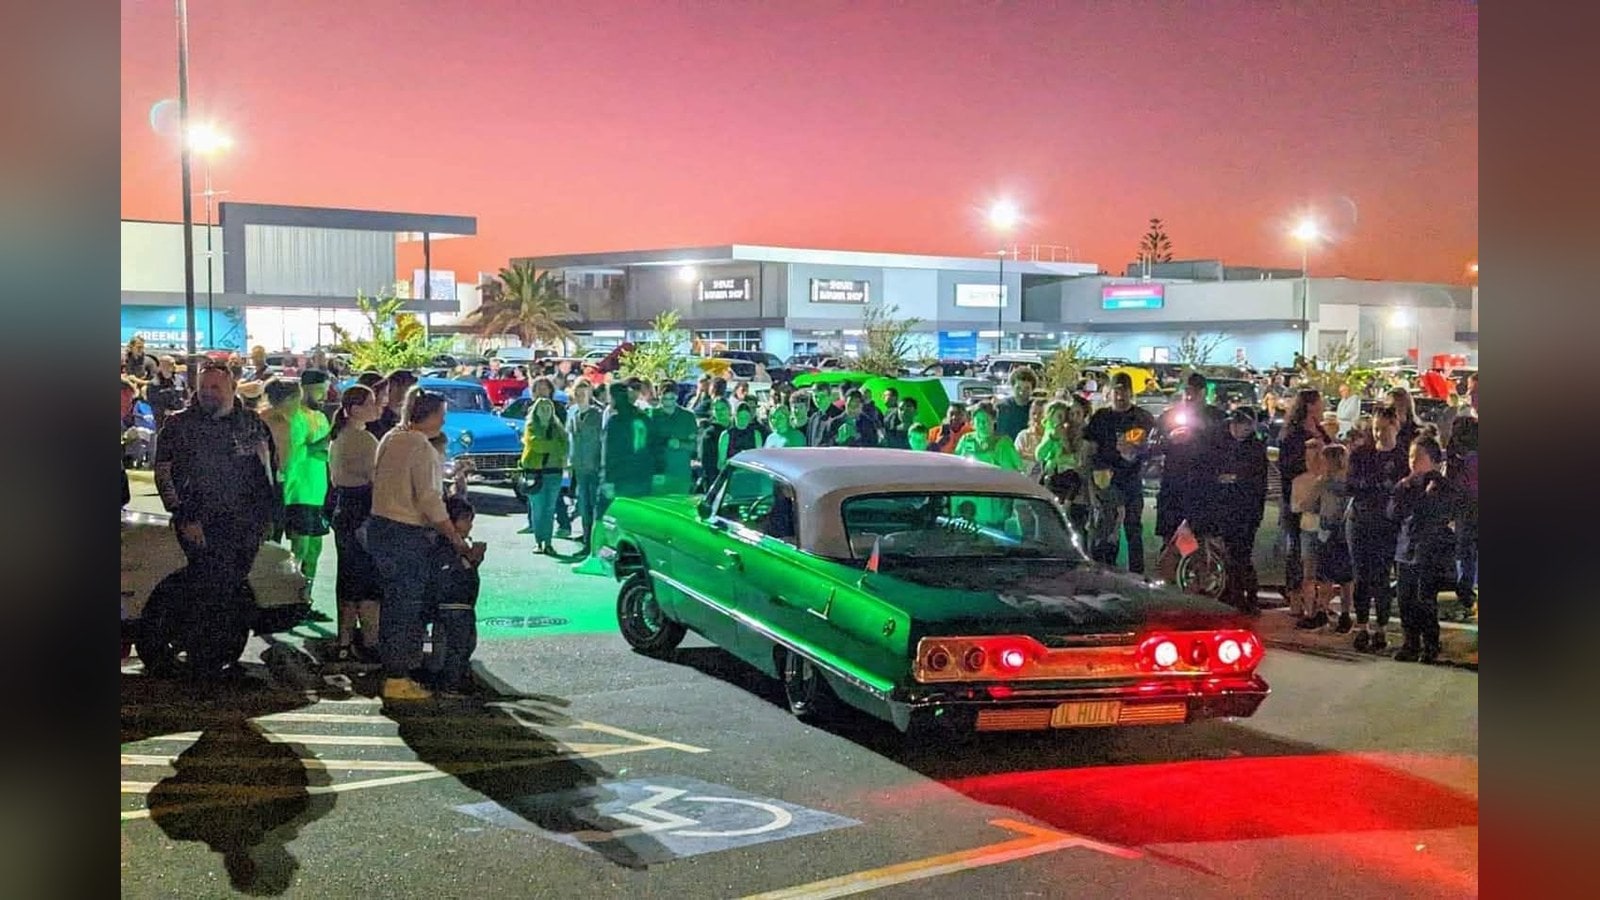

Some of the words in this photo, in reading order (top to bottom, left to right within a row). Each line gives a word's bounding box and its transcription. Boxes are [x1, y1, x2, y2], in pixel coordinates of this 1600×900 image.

[728, 290, 744, 299] SHOP
[846, 291, 863, 301] SHOP
[134, 330, 204, 341] GREENLEF
[1077, 701, 1117, 723] HULK
